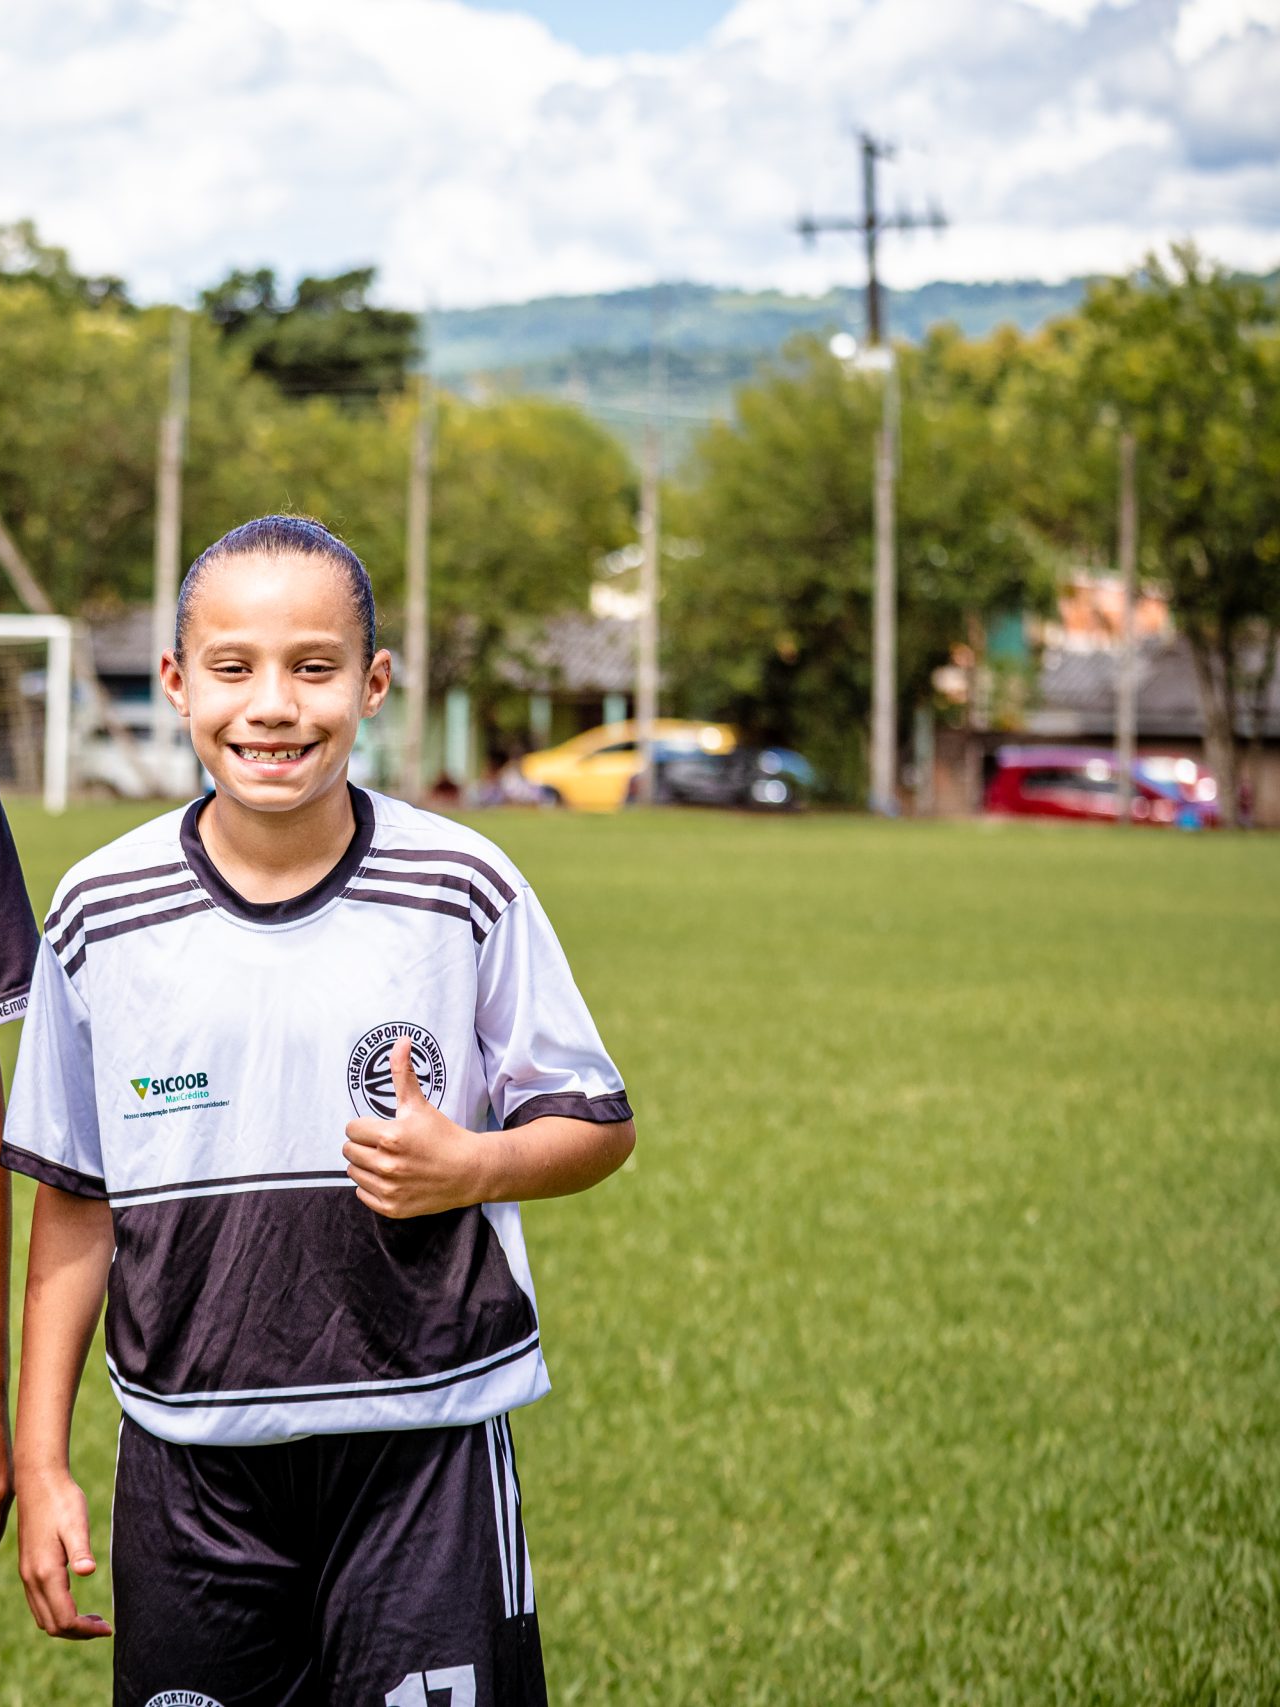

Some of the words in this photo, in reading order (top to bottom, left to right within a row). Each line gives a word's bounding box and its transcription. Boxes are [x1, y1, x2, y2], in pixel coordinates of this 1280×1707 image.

[349, 1046, 368, 1090] GRÊMIO
[365, 1025, 422, 1049] ESPORTIVO
[421, 1035, 443, 1092] SANDENSE
[151, 1072, 209, 1095] SICOOB
